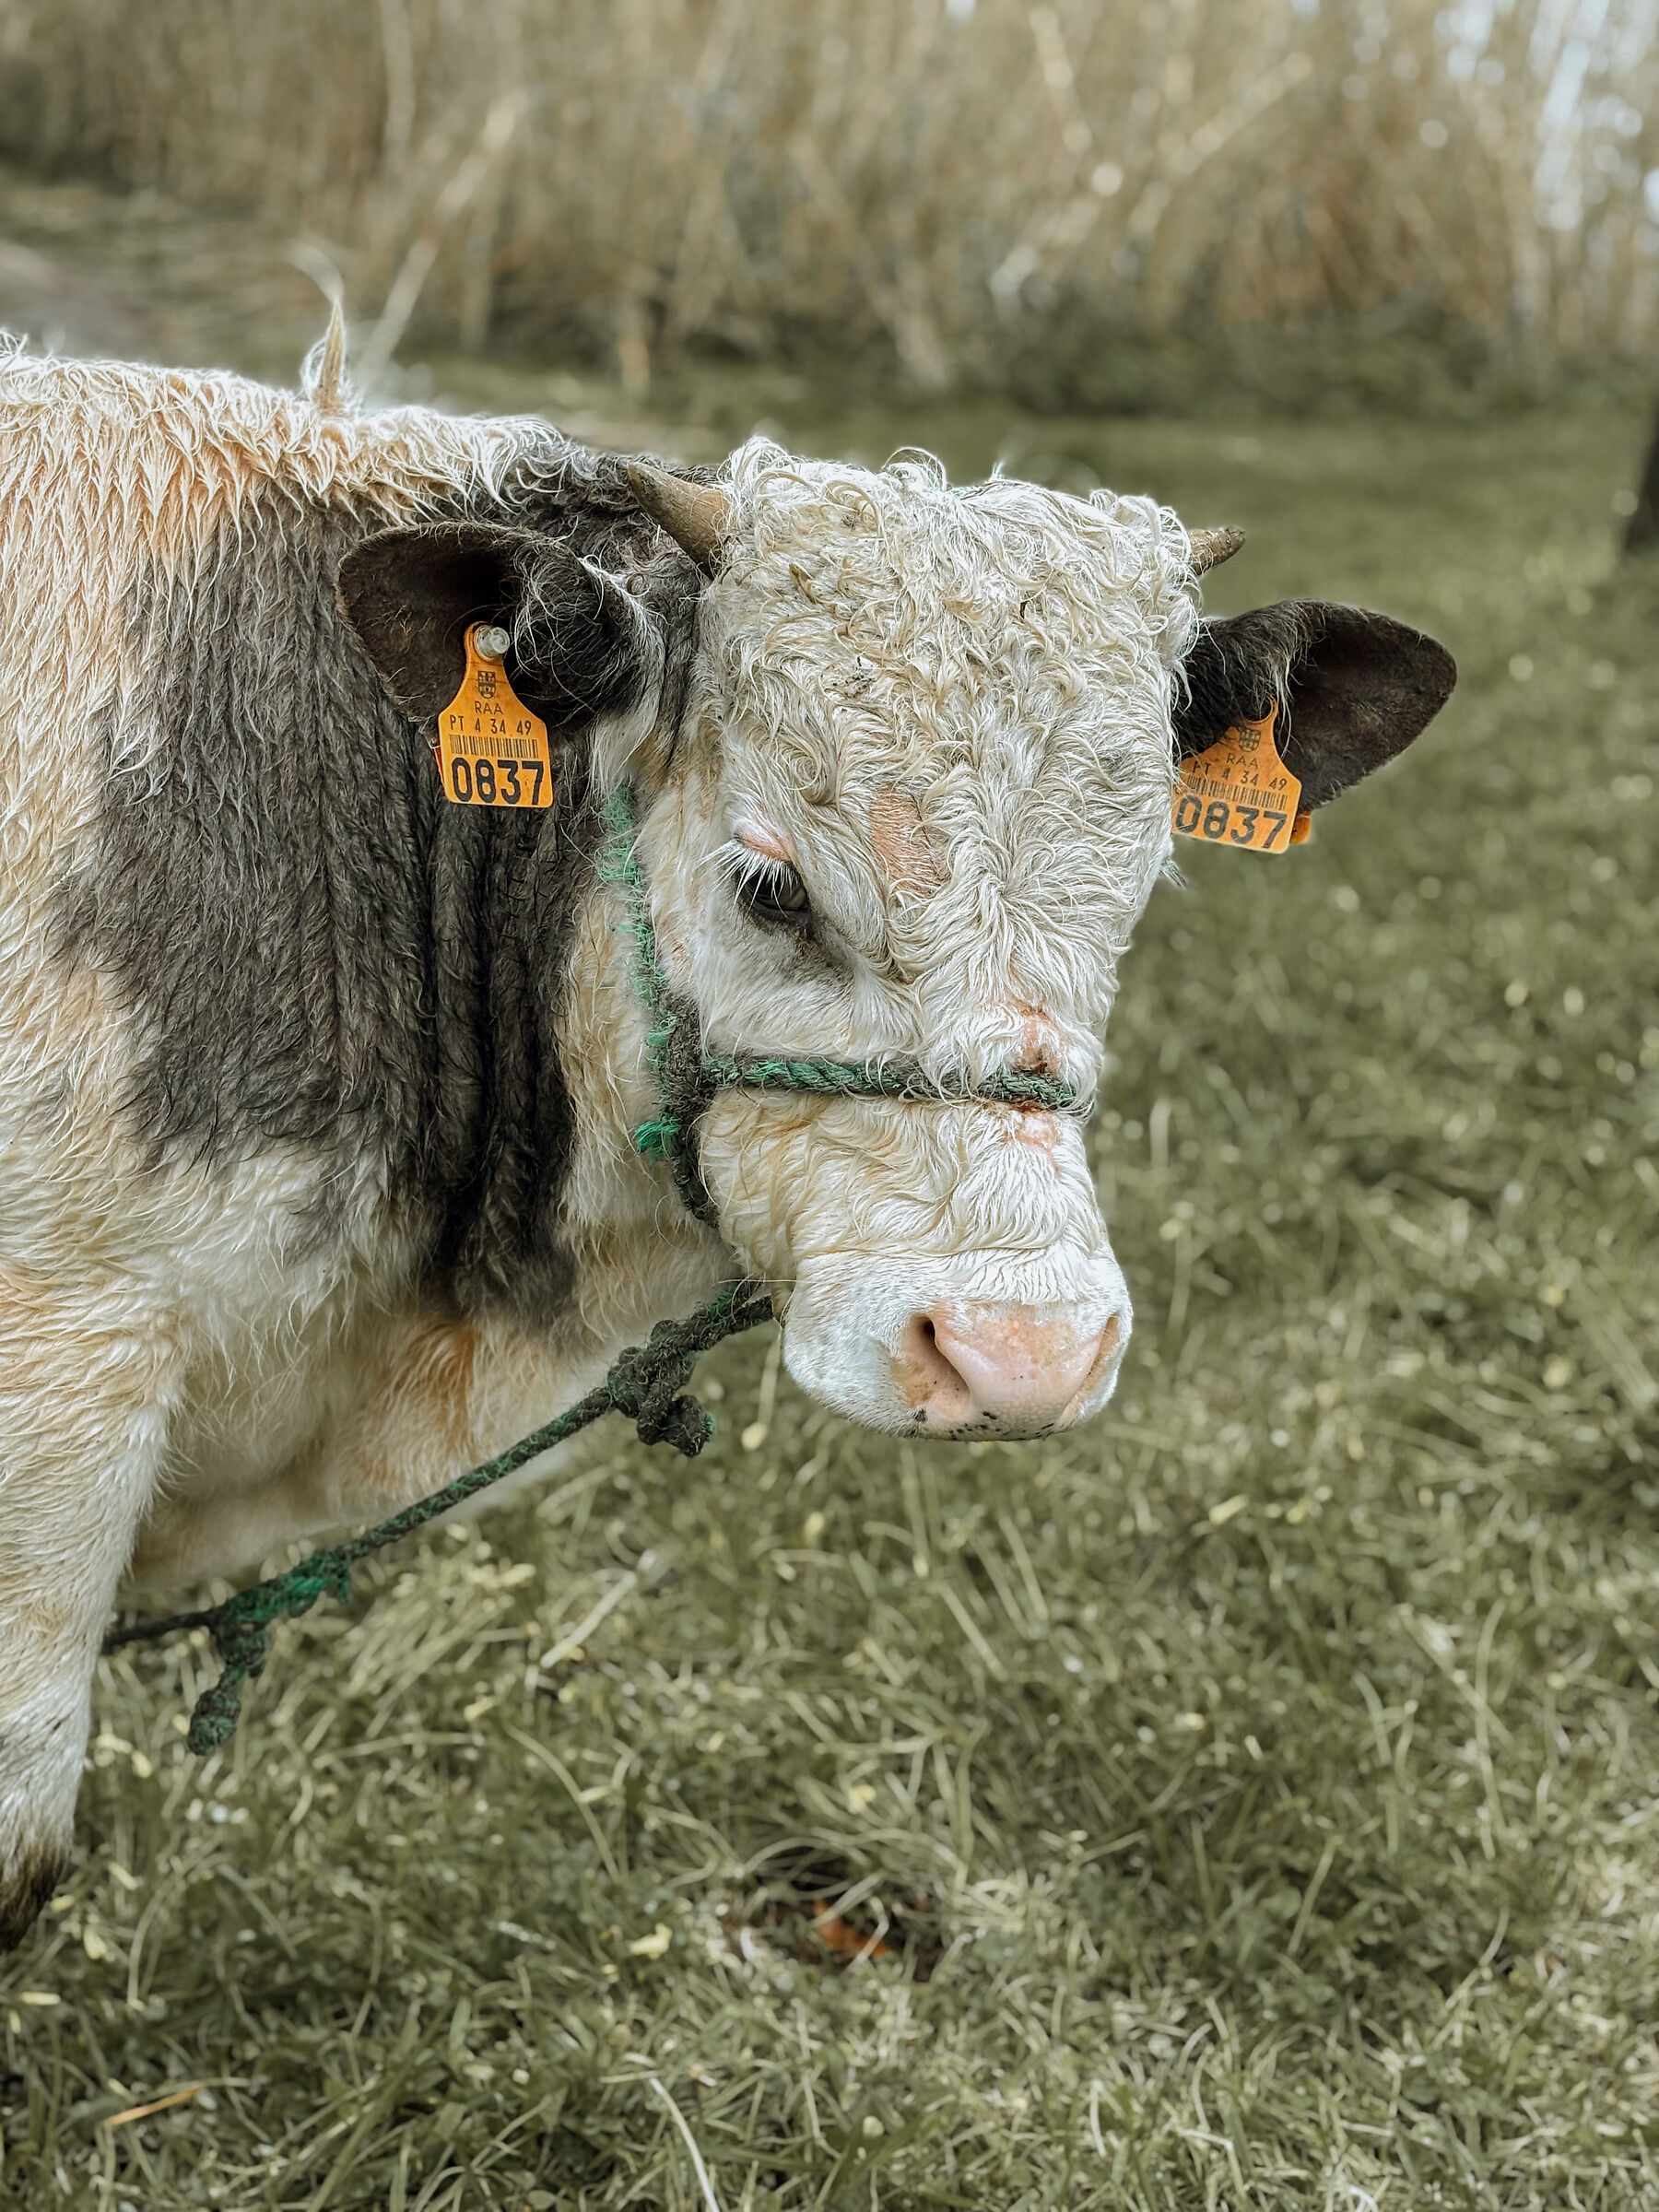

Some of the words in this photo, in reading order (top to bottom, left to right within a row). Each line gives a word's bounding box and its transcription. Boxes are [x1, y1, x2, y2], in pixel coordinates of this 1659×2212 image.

[475, 701, 503, 714] RAA
[450, 715, 464, 731] PT
[475, 718, 481, 733] 4
[490, 718, 506, 734] 34
[516, 720, 532, 735] 49
[1227, 753, 1258, 769] RAA
[452, 757, 544, 806] 0837
[1221, 768, 1230, 781] 4
[1241, 771, 1259, 786] 34
[1269, 778, 1288, 791] 49
[1176, 795, 1288, 849] 0837
